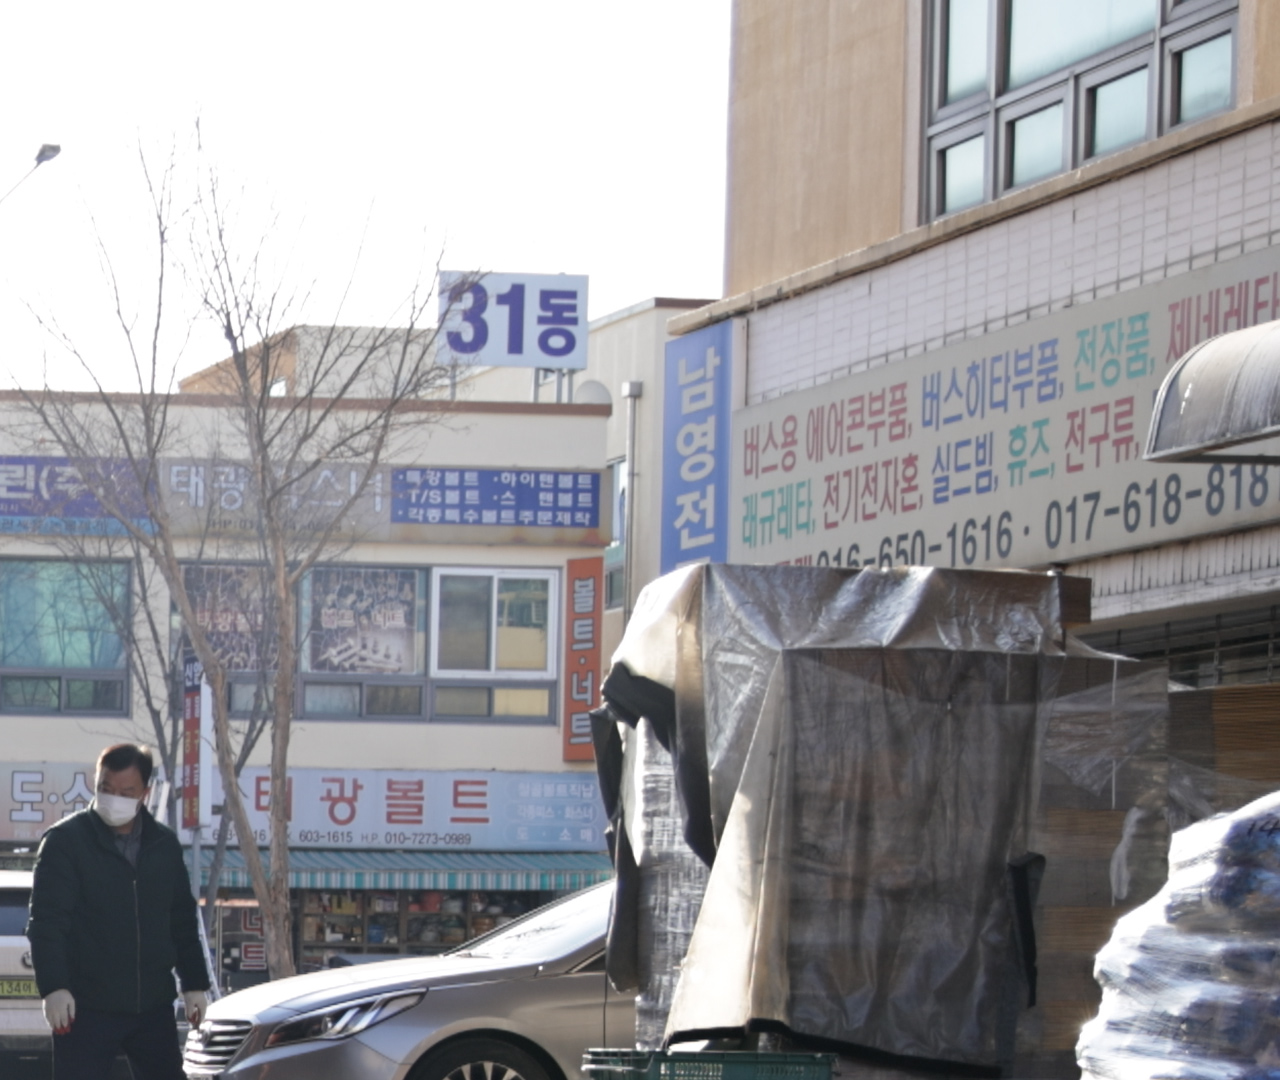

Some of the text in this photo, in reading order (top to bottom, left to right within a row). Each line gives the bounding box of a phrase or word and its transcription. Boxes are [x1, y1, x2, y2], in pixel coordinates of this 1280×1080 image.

[446, 282, 579, 357] 31동
[743, 413, 798, 480] 버스용
[806, 381, 913, 463] 에어콘부품,
[921, 337, 1065, 432] 버스히타부품,
[1074, 310, 1156, 393] 전장품,
[170, 465, 383, 513] 태광스너
[673, 346, 721, 568] 남영전
[742, 477, 816, 549] 래규레타,
[822, 452, 924, 532] 전기전자혼,
[1007, 416, 1055, 488] 휴즈,
[1065, 396, 1140, 475] 전구류,
[1044, 463, 1280, 550] 017-618-818
[570, 577, 595, 745] 볼트·너트
[255, 775, 490, 826] 태광볼트
